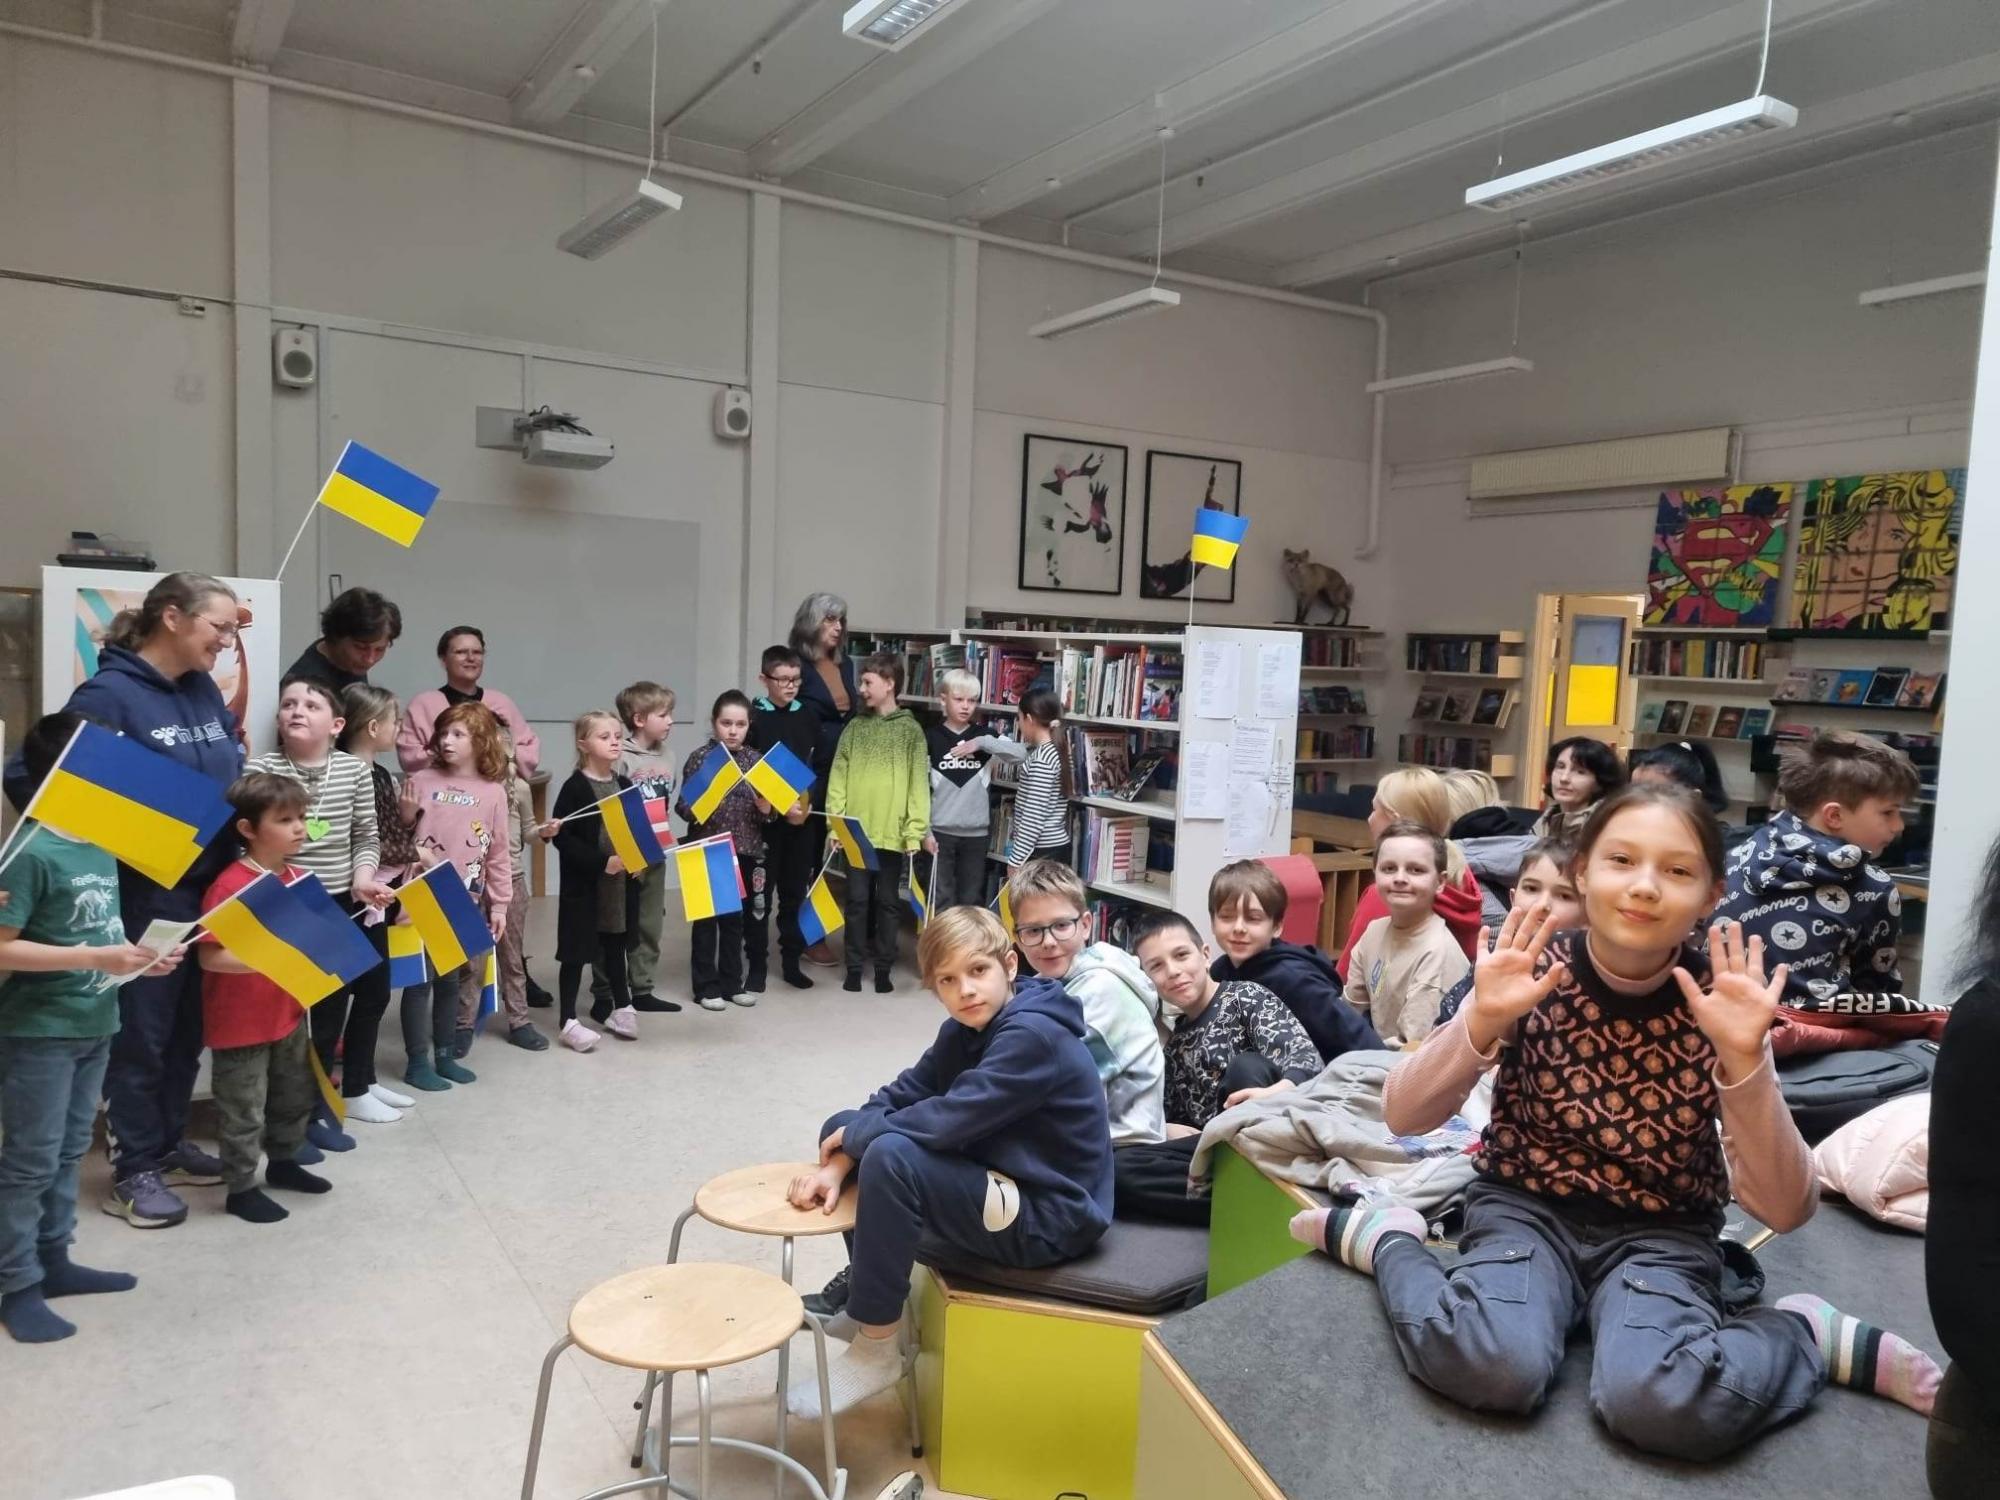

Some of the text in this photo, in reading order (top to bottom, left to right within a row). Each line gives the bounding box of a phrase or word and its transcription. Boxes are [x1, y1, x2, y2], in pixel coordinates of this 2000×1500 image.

[938, 756, 981, 770] adidas
[1739, 895, 1809, 923] Converse
[1818, 993, 1891, 1014] FREE
